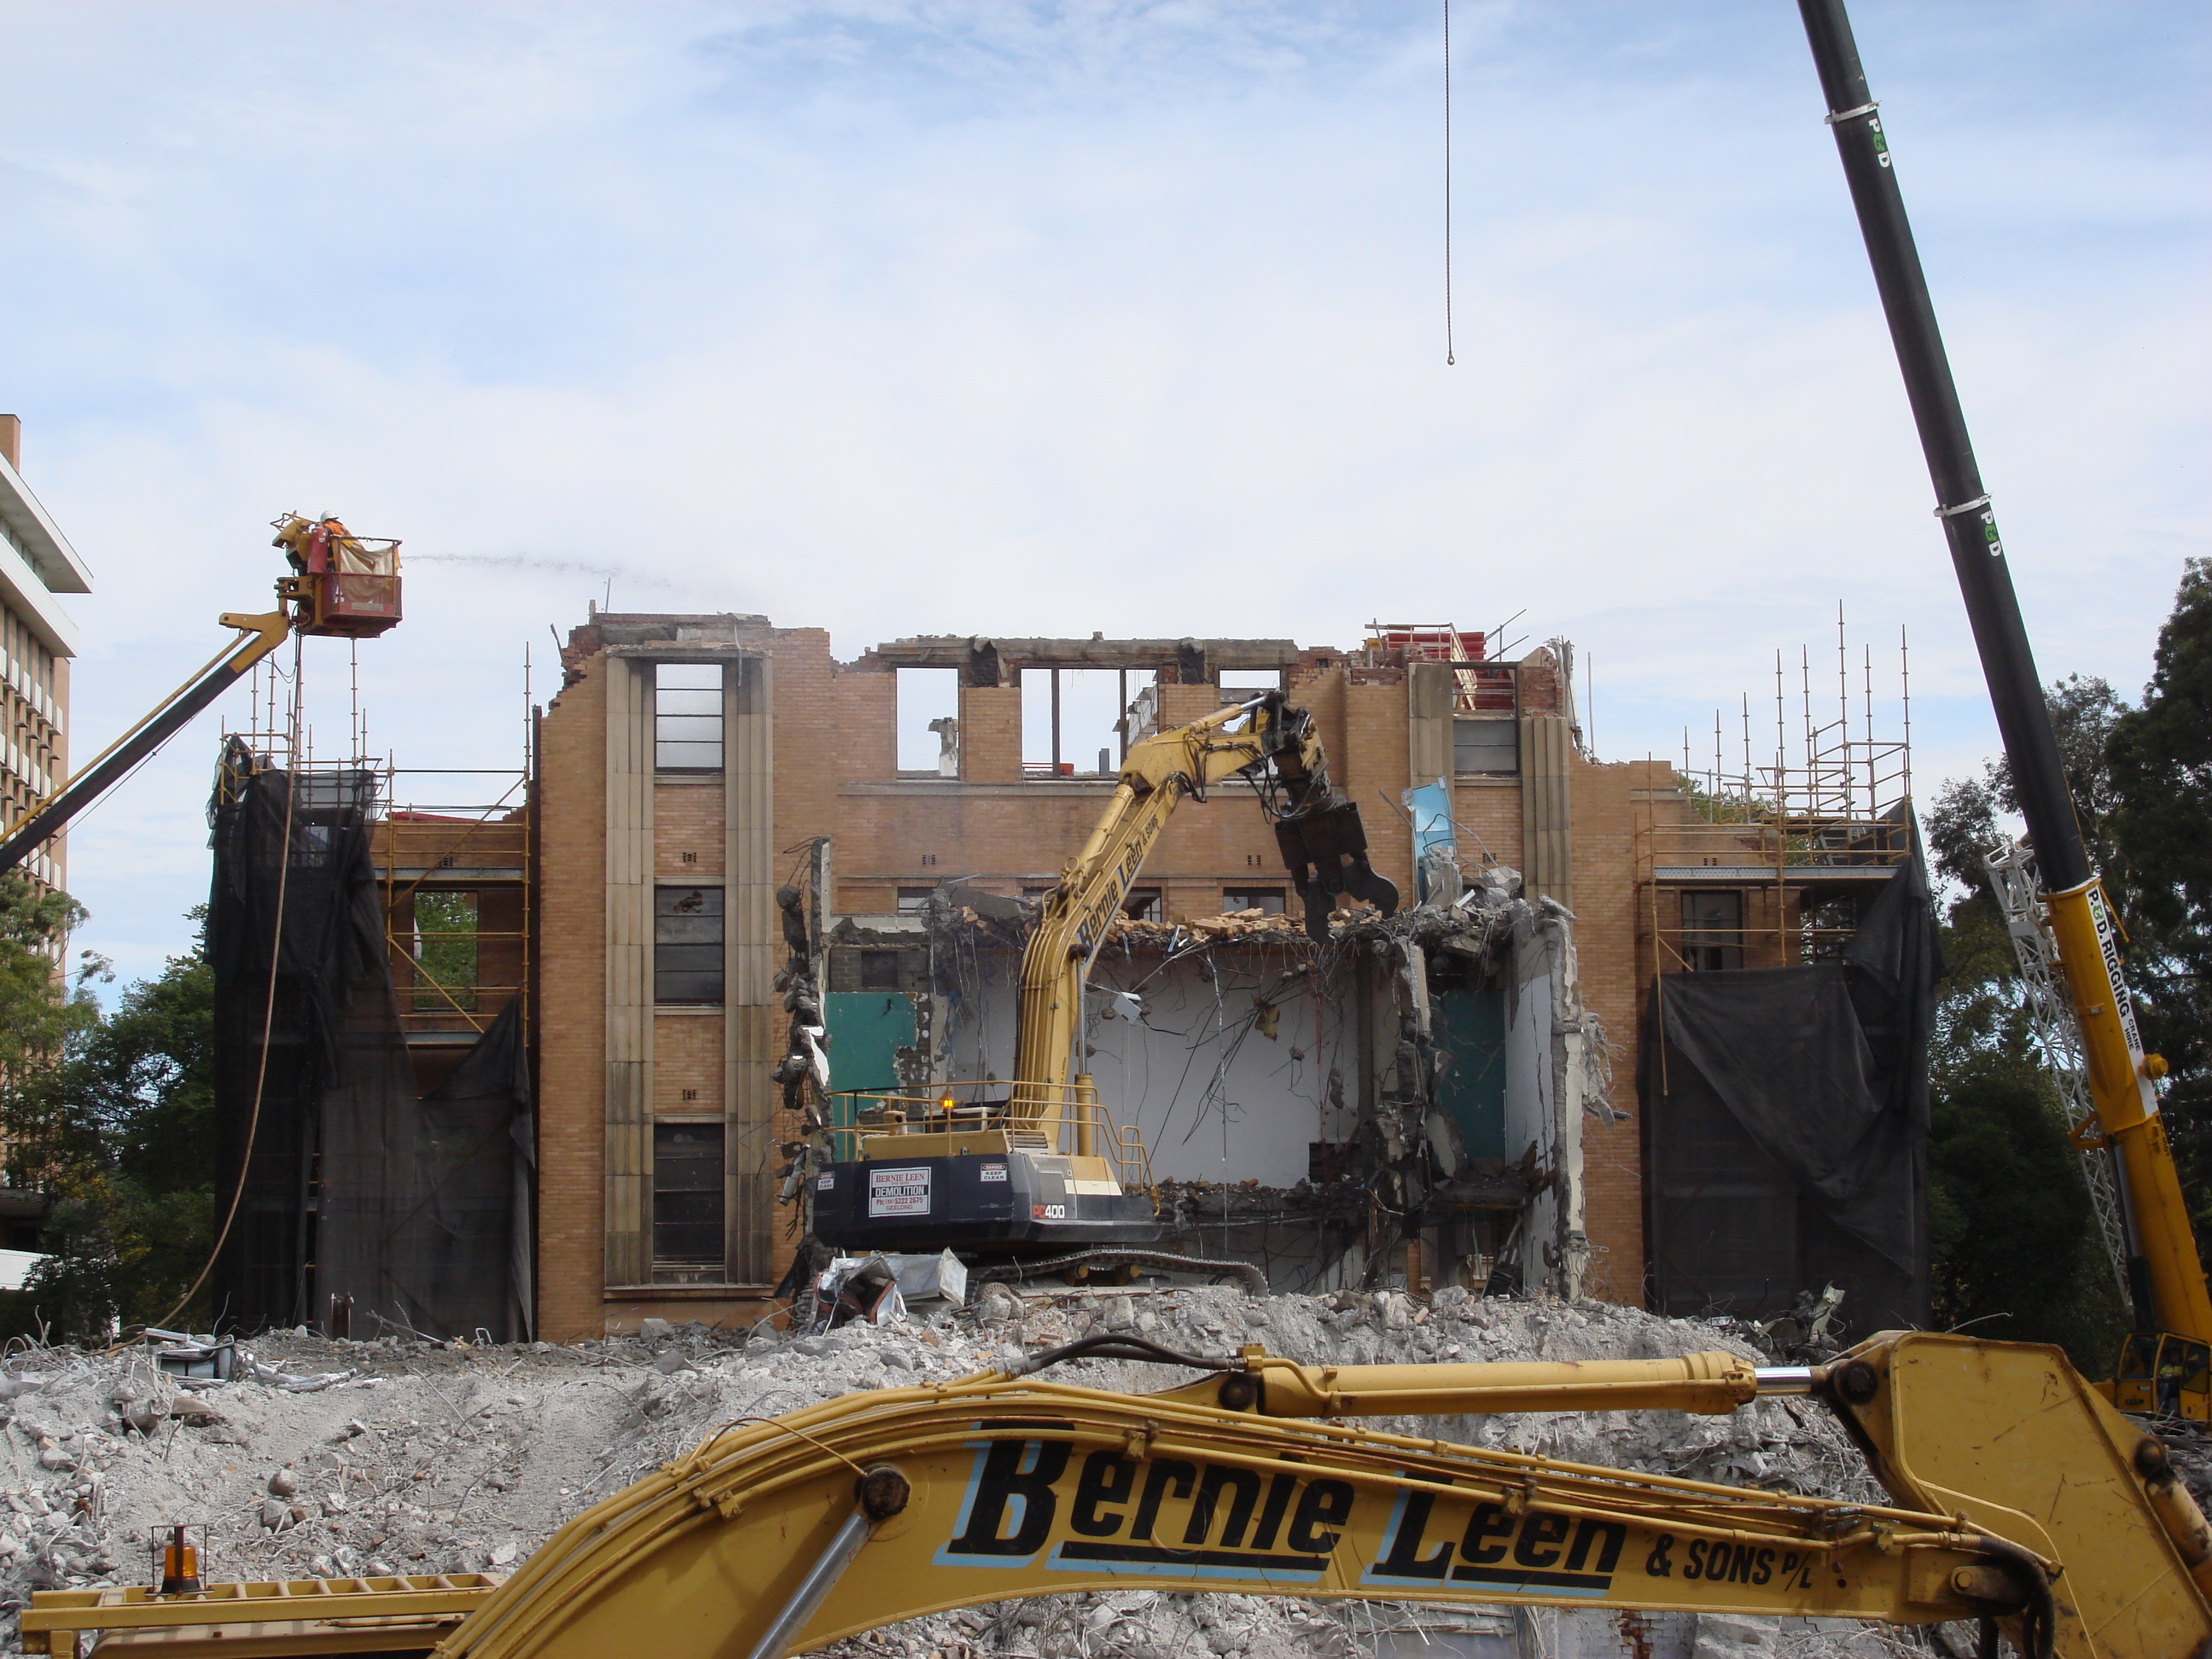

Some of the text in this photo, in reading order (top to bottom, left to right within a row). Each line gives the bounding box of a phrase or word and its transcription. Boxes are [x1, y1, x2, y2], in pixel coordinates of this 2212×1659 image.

[1076, 879, 1120, 952] Bernie
[1118, 840, 1144, 890] Leen
[2101, 939, 2131, 1018] RIGGING
[2124, 1027, 2134, 1051] HIRE
[2128, 1018, 2141, 1051] CRANE
[876, 1173, 925, 1183] BERNIE LEEN
[875, 1185, 924, 1197] DEMOLITION
[894, 1196, 908, 1205] 5222
[1033, 1204, 1065, 1219] PC400
[943, 1417, 1813, 1592] Bernie Leen & SONS P/L
